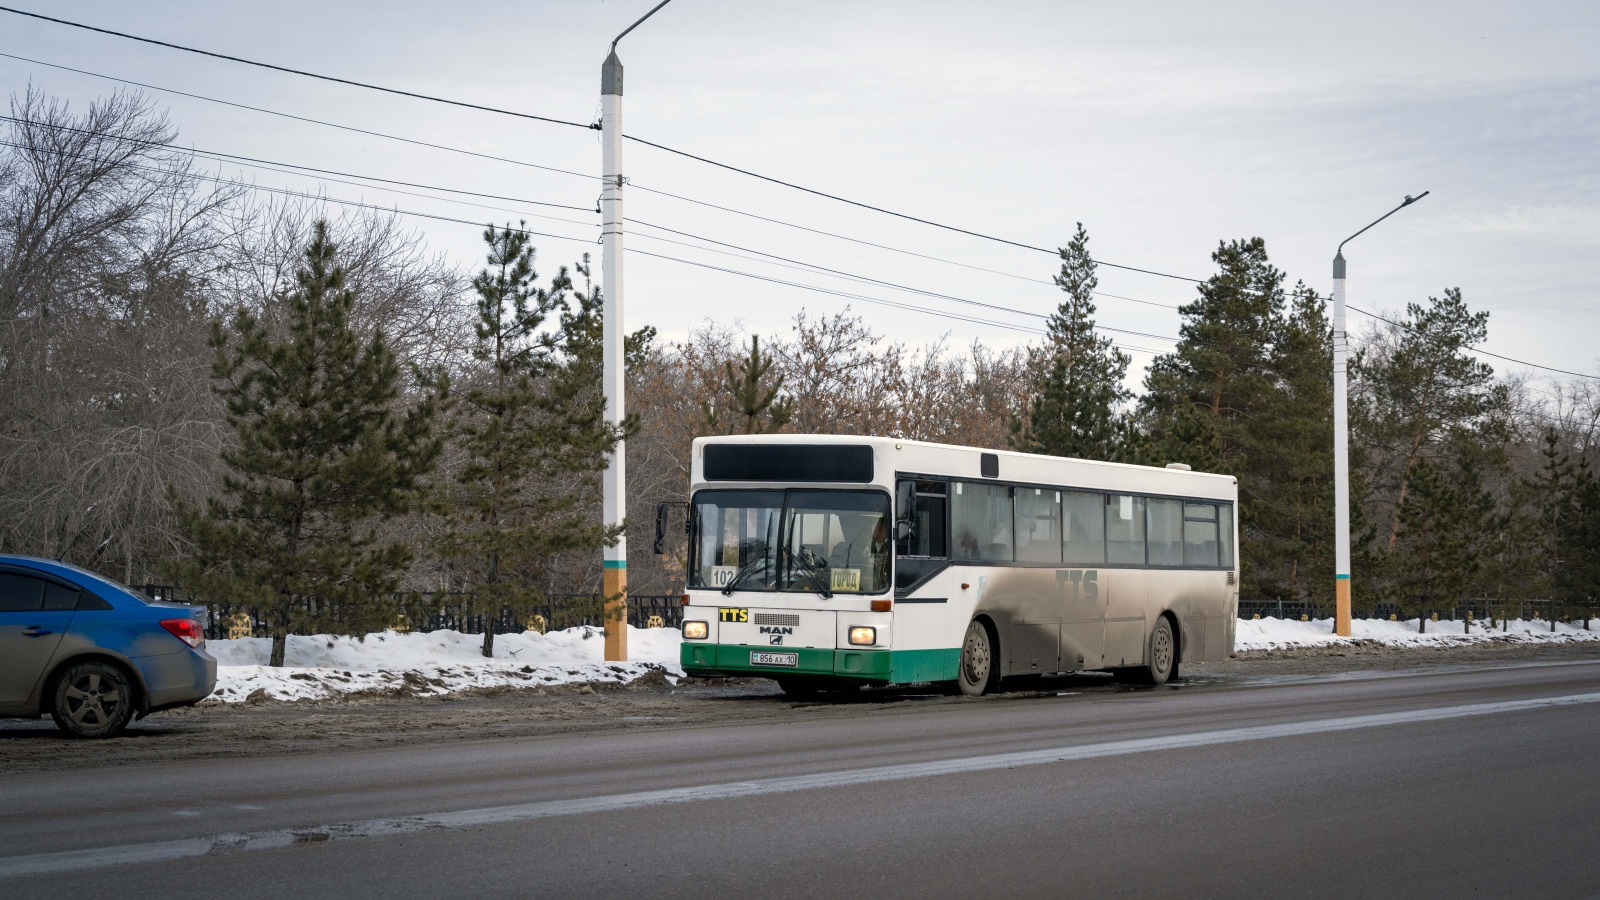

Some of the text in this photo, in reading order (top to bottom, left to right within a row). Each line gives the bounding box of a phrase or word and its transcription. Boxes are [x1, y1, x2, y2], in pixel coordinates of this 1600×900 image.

[713, 570, 734, 586] 102
[832, 571, 858, 590] ГОРОД
[1055, 569, 1099, 608] TTS
[719, 608, 748, 622] TTS
[759, 626, 793, 635] MAN
[759, 654, 773, 663] 856
[786, 655, 795, 664] 10
